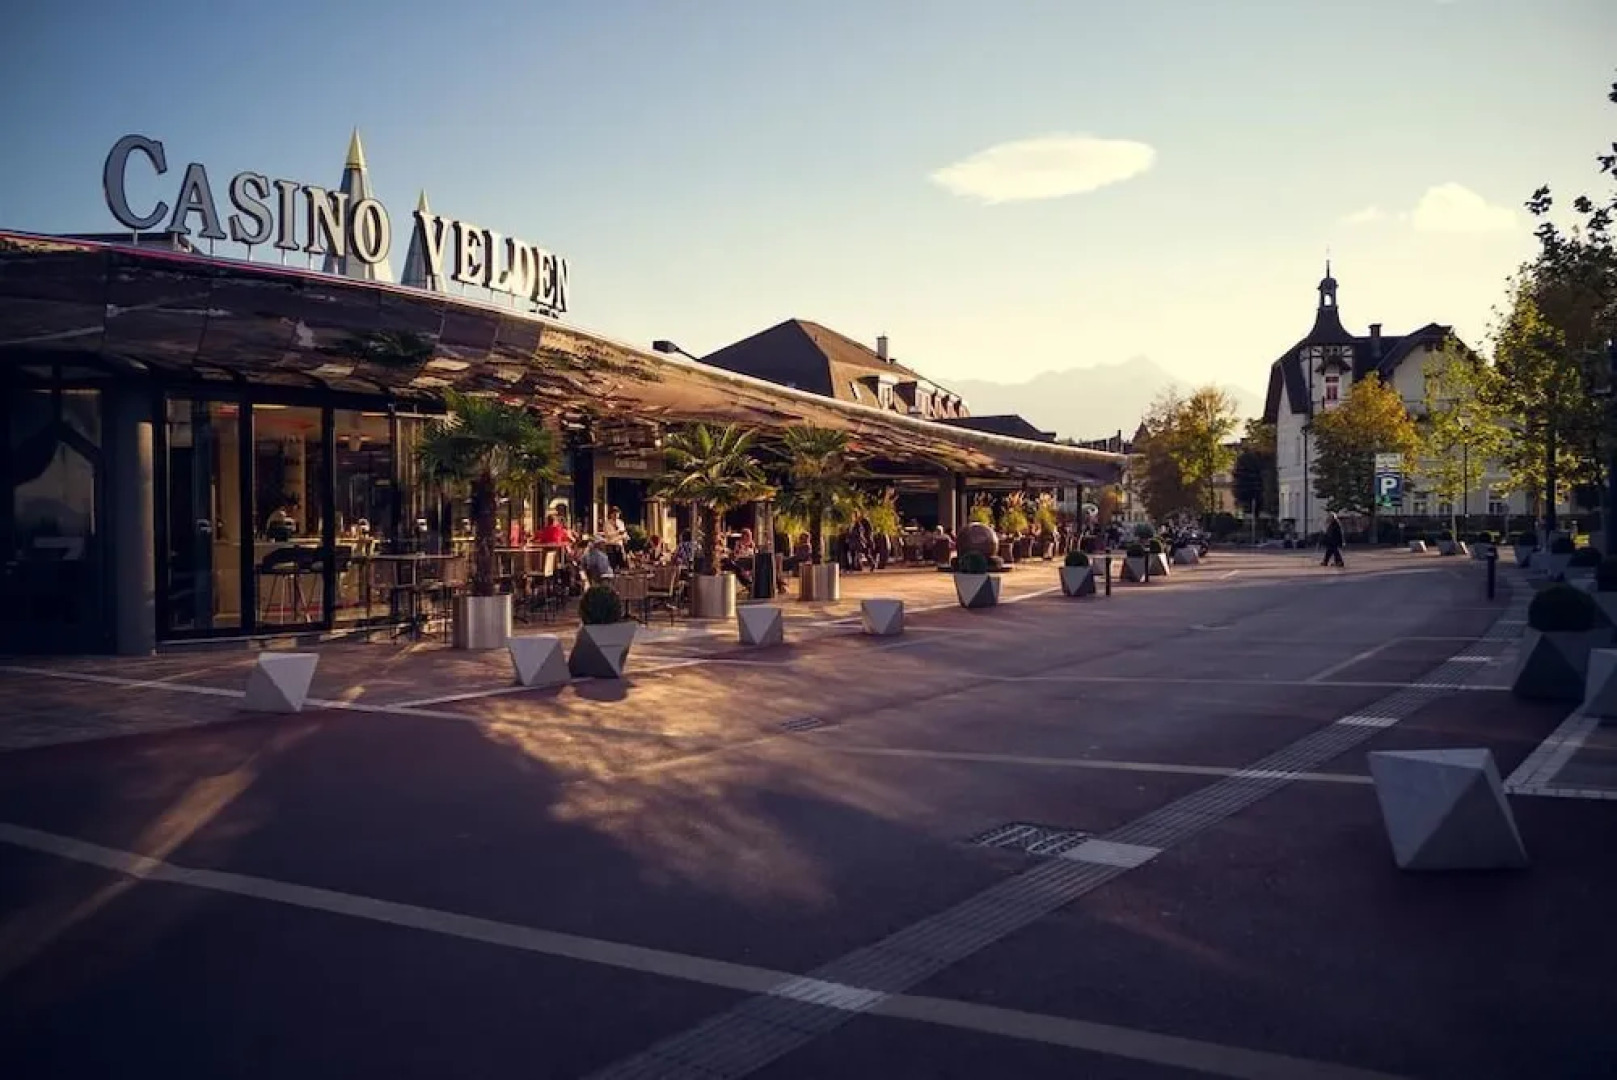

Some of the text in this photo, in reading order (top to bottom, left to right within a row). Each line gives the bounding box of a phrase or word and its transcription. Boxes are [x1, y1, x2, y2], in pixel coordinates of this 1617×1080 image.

[102, 134, 570, 313] CASINO VELDEN
[1380, 477, 1398, 496] P
